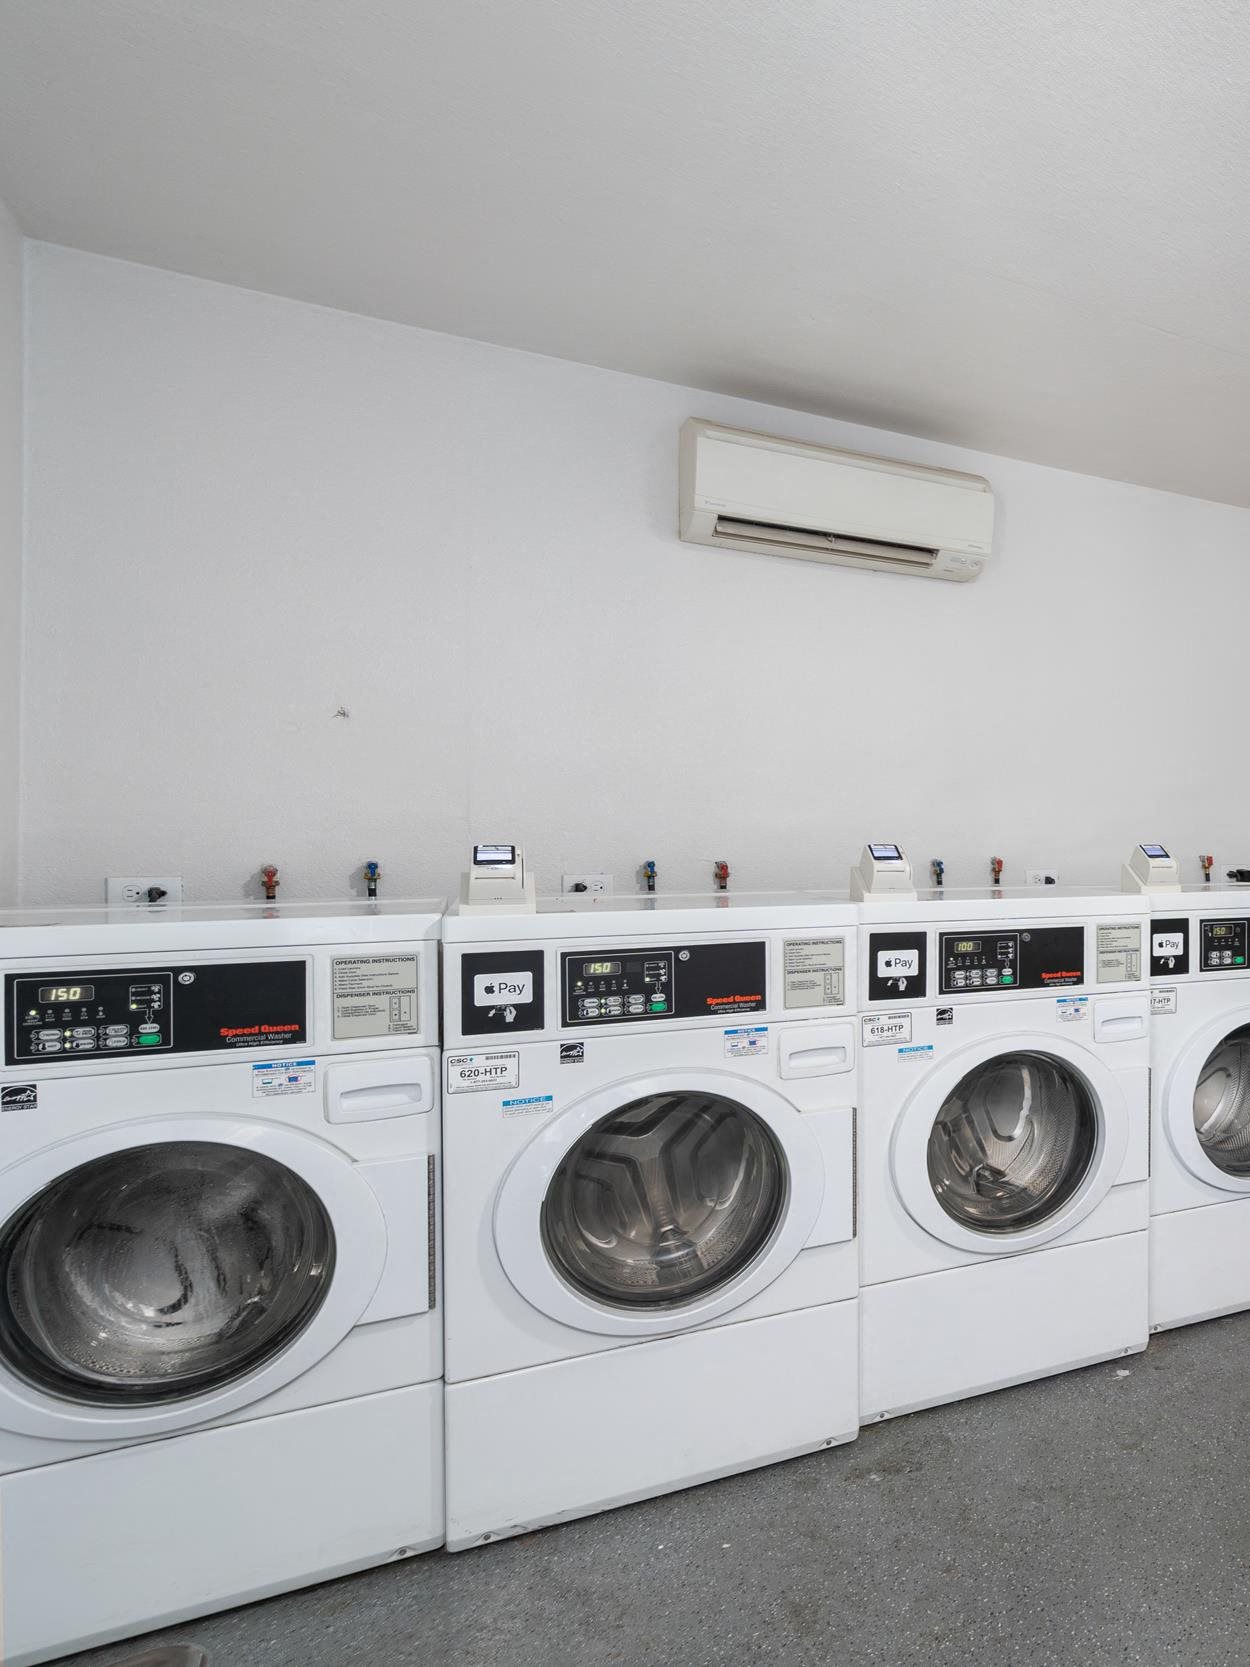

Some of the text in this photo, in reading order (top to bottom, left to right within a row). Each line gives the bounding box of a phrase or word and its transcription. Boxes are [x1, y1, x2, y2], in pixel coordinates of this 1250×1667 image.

[957, 942, 973, 951] 100
[1165, 940, 1180, 949] Pay
[590, 962, 611, 974] 150
[894, 957, 914, 969] Pay
[50, 987, 81, 1001] 150
[498, 982, 526, 996] Pay
[706, 996, 734, 1005] Speed
[1150, 997, 1171, 1005] 17-HTP
[220, 1024, 300, 1036] Speed Queen
[870, 1024, 904, 1035] 618-HTP
[226, 1032, 293, 1043] Commercial Washer
[459, 1066, 508, 1079] 620-HTP
[509, 1096, 547, 1106] NOTICE
